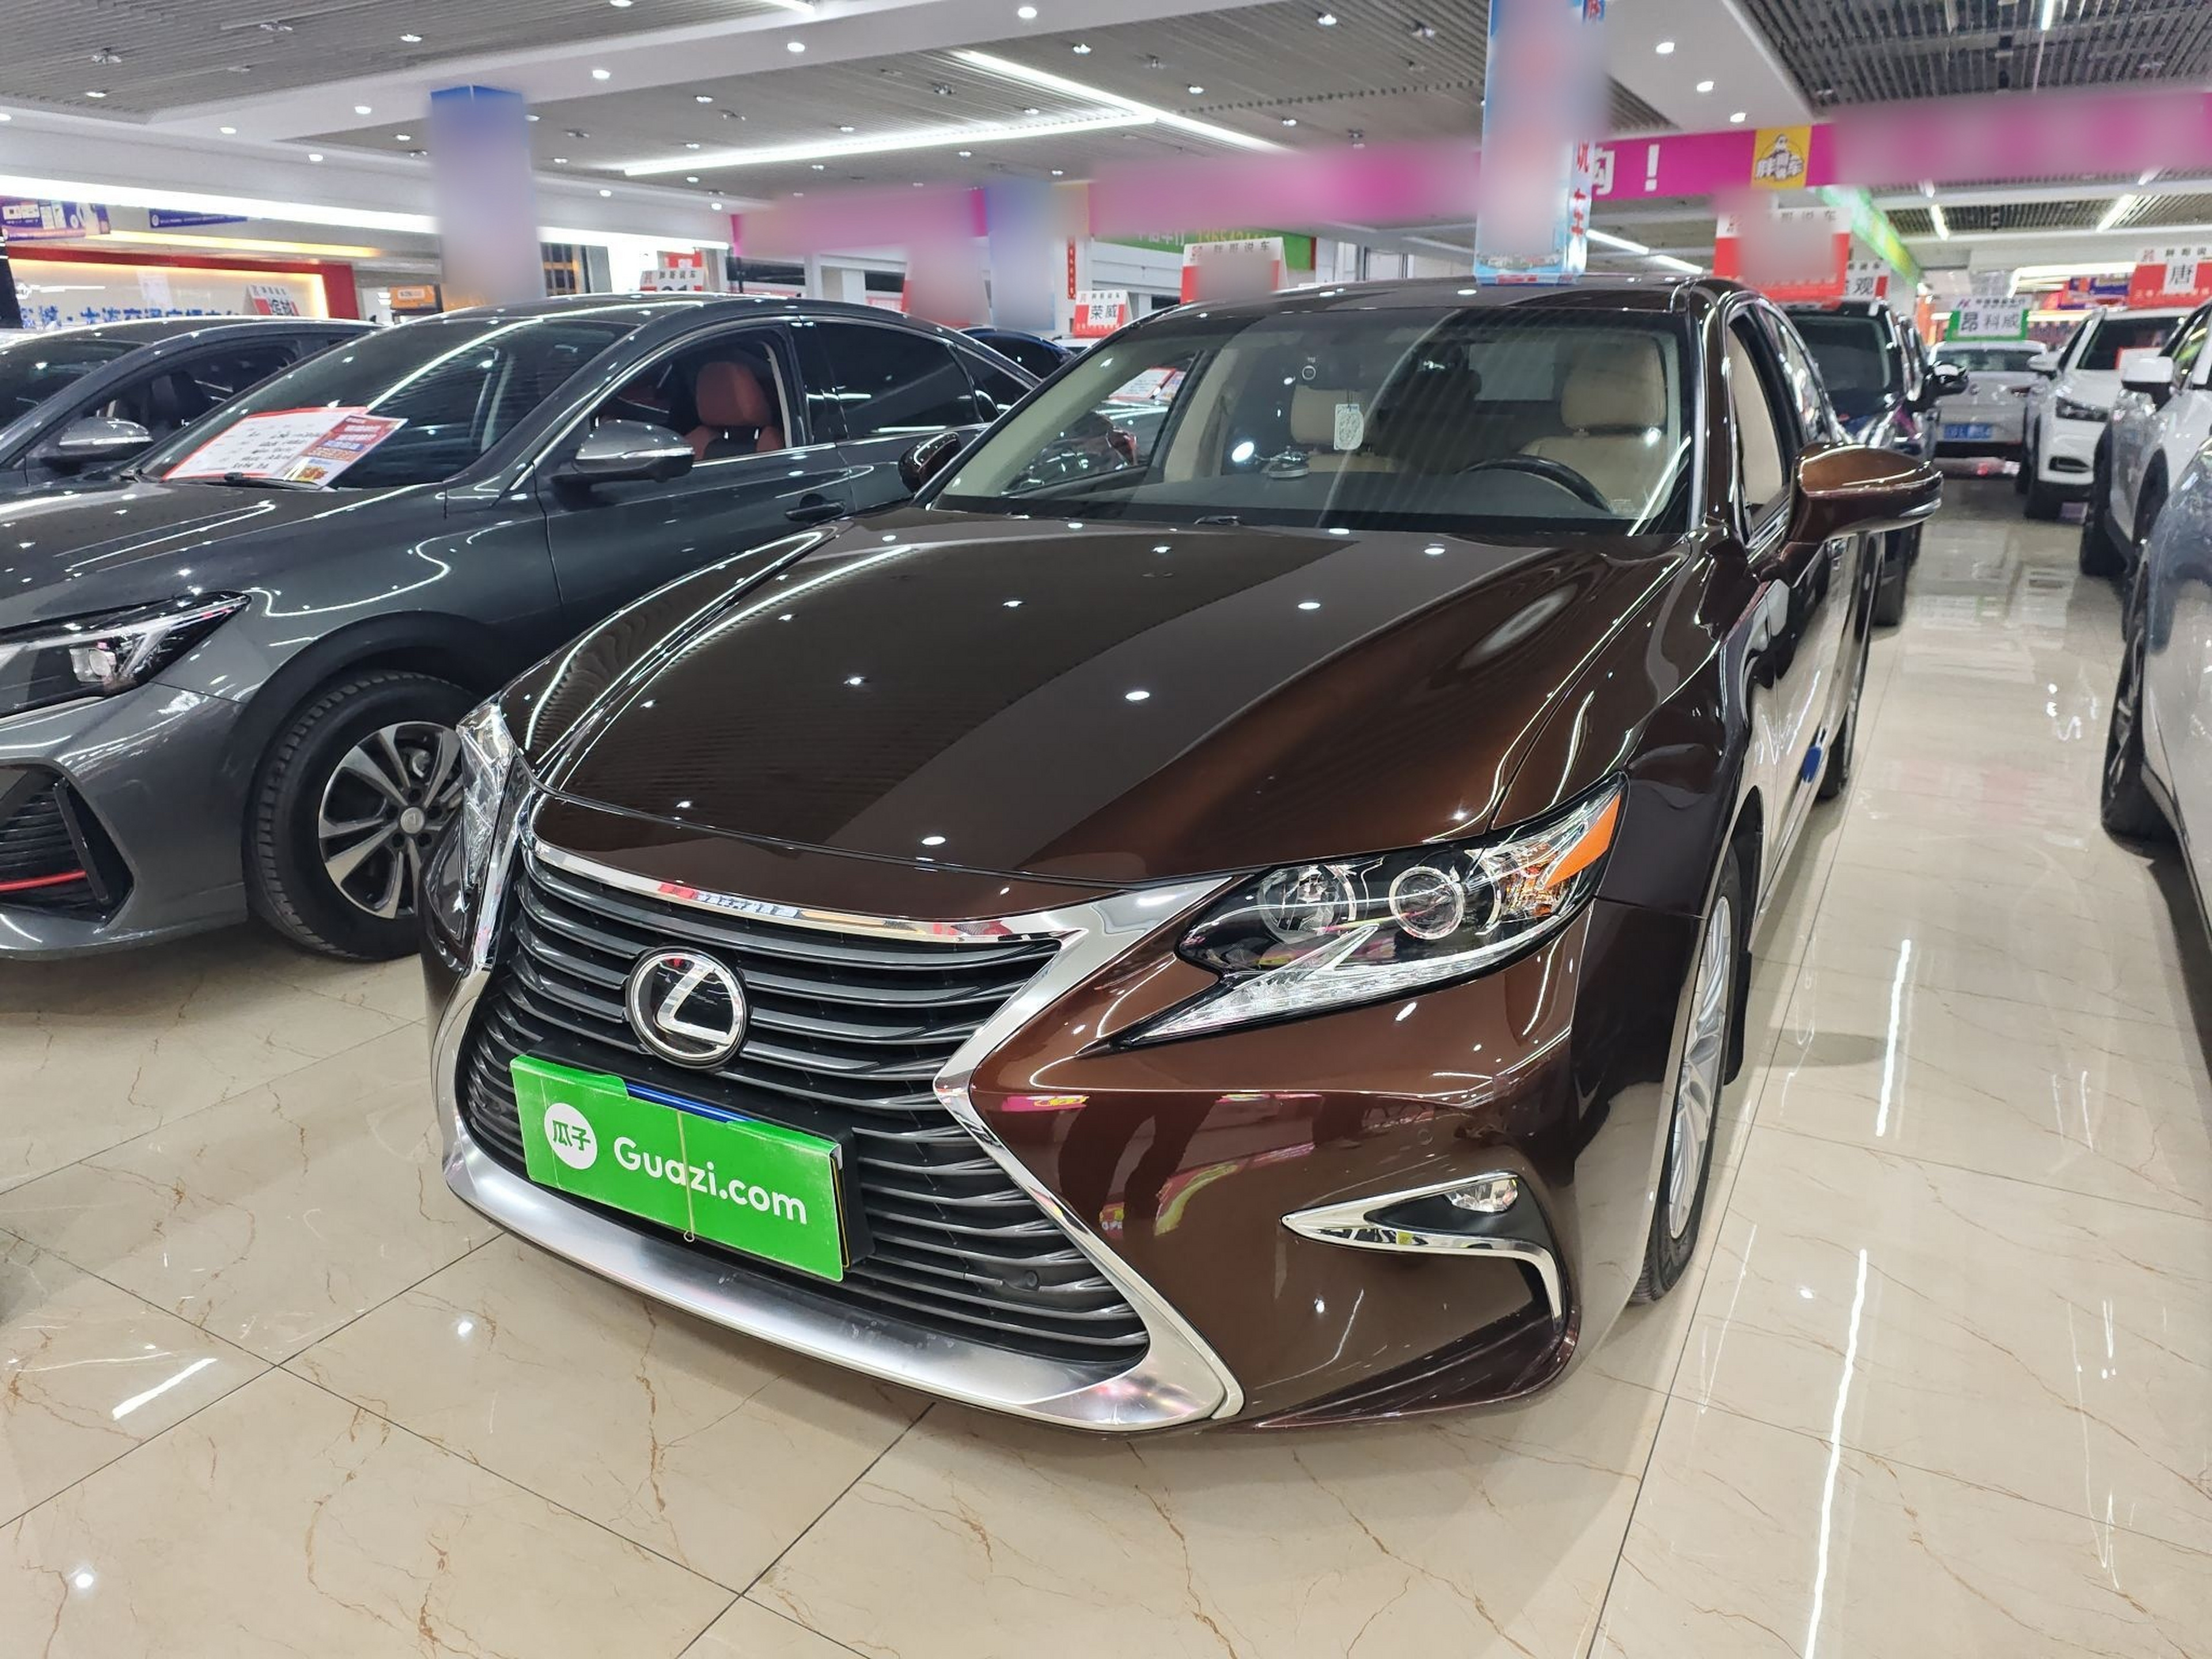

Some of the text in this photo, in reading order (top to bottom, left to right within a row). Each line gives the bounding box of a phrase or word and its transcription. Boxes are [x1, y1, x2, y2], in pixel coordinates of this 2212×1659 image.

[2169, 264, 2192, 285] 唐
[1090, 305, 1118, 319] 荣威
[1961, 311, 2020, 332] 昂科威
[552, 1120, 590, 1151] 瓜子
[614, 1137, 807, 1225] Guazi.com
